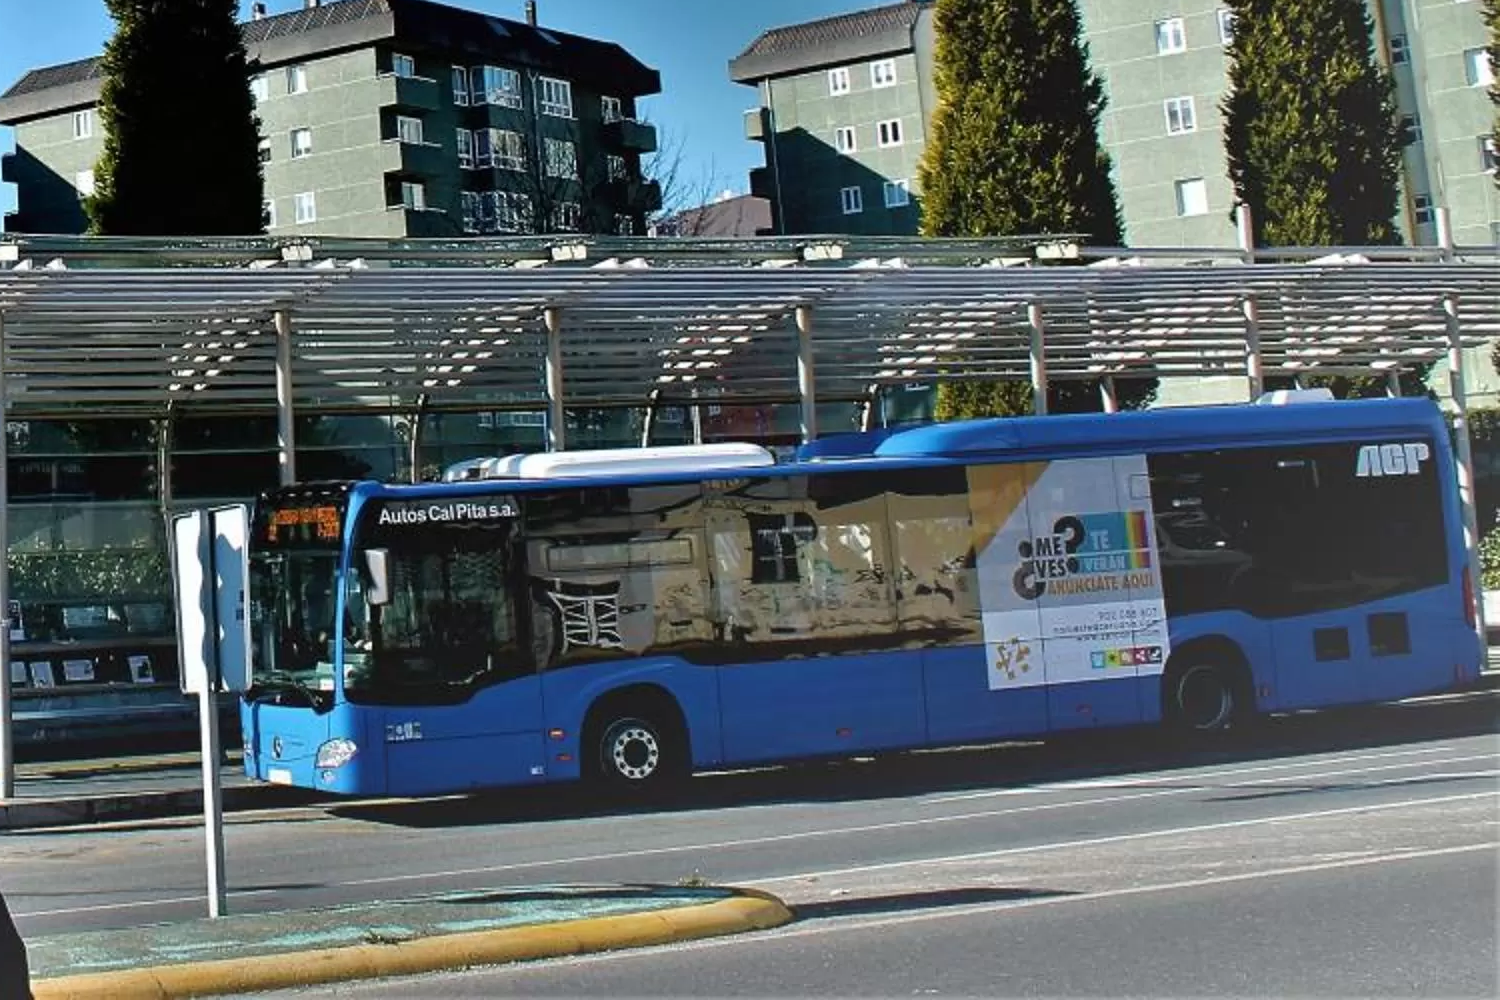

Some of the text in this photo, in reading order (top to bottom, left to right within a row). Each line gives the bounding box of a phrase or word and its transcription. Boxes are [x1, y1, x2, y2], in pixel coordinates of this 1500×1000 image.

[379, 507, 427, 525] Autos
[428, 504, 455, 521] Cal
[456, 503, 488, 519] Pita
[1090, 530, 1110, 550] TE
